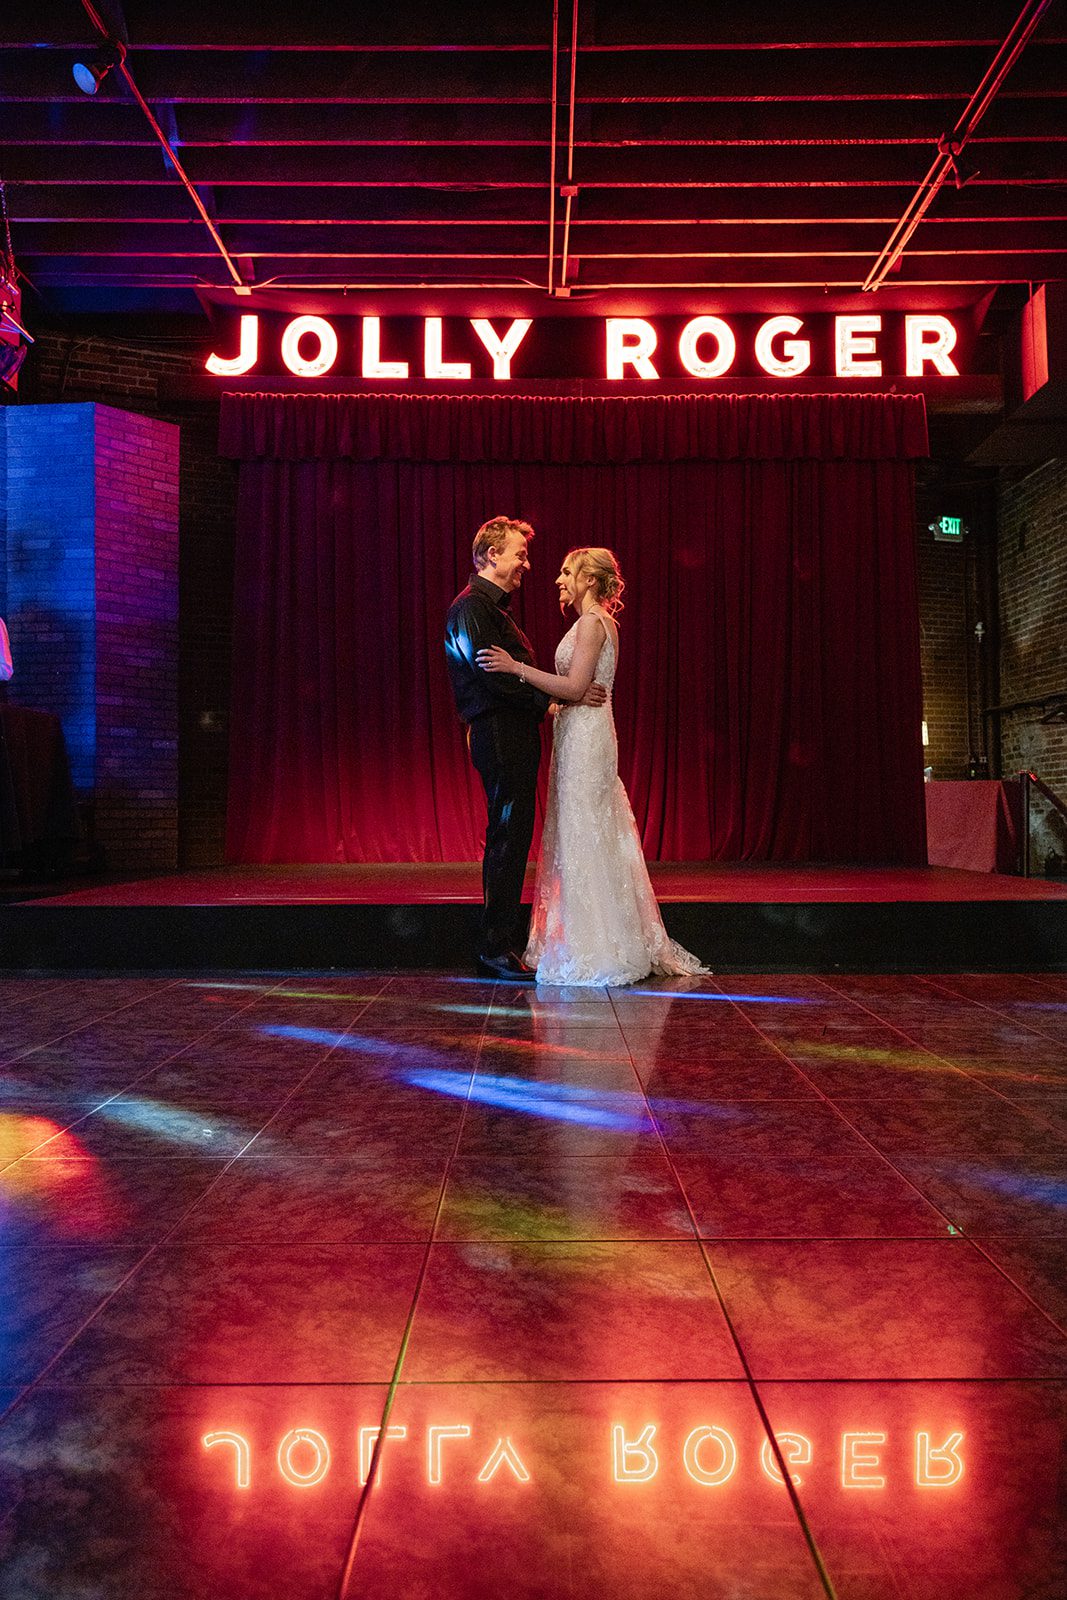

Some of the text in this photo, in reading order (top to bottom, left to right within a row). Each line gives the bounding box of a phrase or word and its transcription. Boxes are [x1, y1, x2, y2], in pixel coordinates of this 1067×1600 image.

[205, 315, 960, 380] JOLLY ROGER
[942, 516, 961, 535] EXIT
